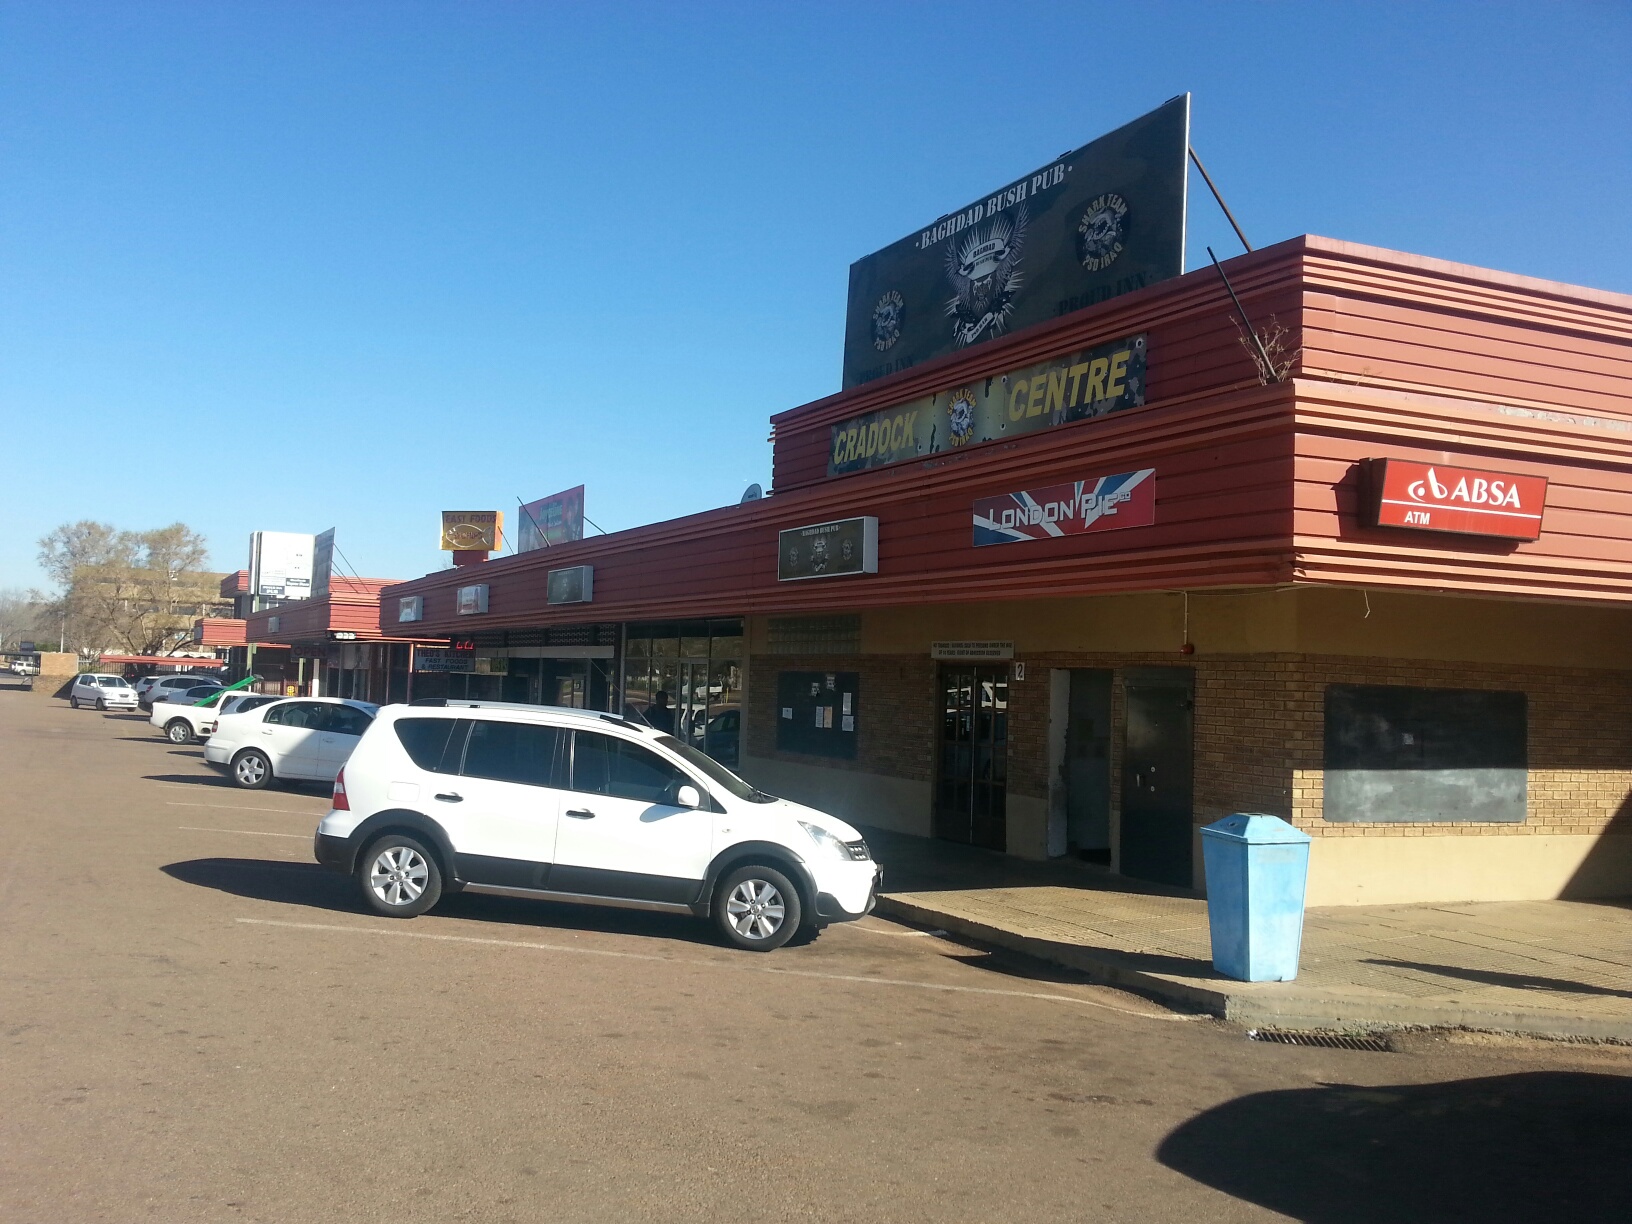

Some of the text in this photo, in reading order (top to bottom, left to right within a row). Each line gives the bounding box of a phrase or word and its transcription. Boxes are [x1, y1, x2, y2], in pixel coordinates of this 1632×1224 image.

[920, 163, 1065, 250] BAGHDAD BUSH PUB
[1078, 193, 1128, 234] SHARK TEAM
[1082, 241, 1123, 271] PSD IRAQ
[833, 350, 1131, 465] CRADOCK CENTRE
[988, 499, 1074, 531] LONDON
[1080, 492, 1118, 519] PIE
[1450, 476, 1521, 509] ABSA
[1404, 510, 1431, 525] ATM
